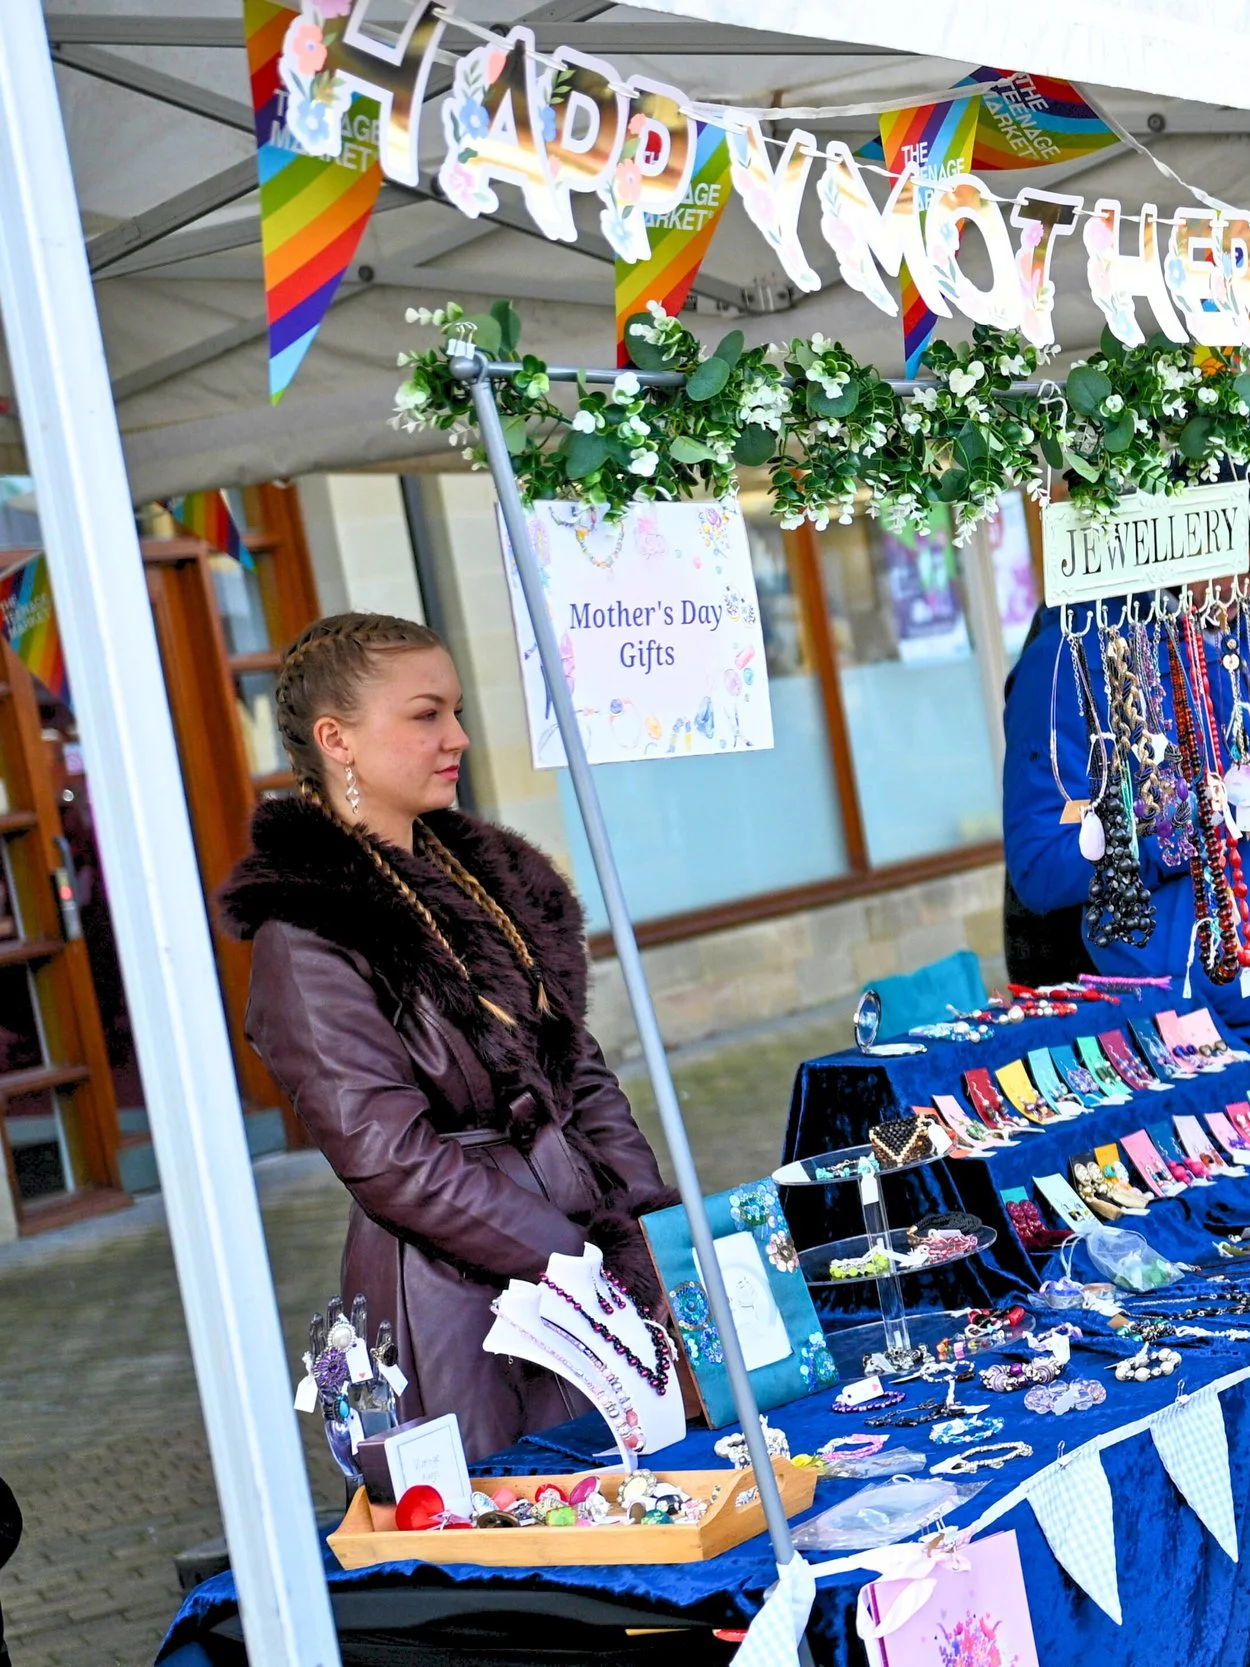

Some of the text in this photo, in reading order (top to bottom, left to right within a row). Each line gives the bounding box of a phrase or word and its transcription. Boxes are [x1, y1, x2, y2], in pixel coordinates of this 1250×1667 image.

[1015, 73, 1049, 112] THE
[901, 142, 928, 164] THE
[1061, 507, 1238, 577] JEWELLERY
[569, 600, 722, 632] Mother's Day
[620, 639, 675, 675] Gifts
